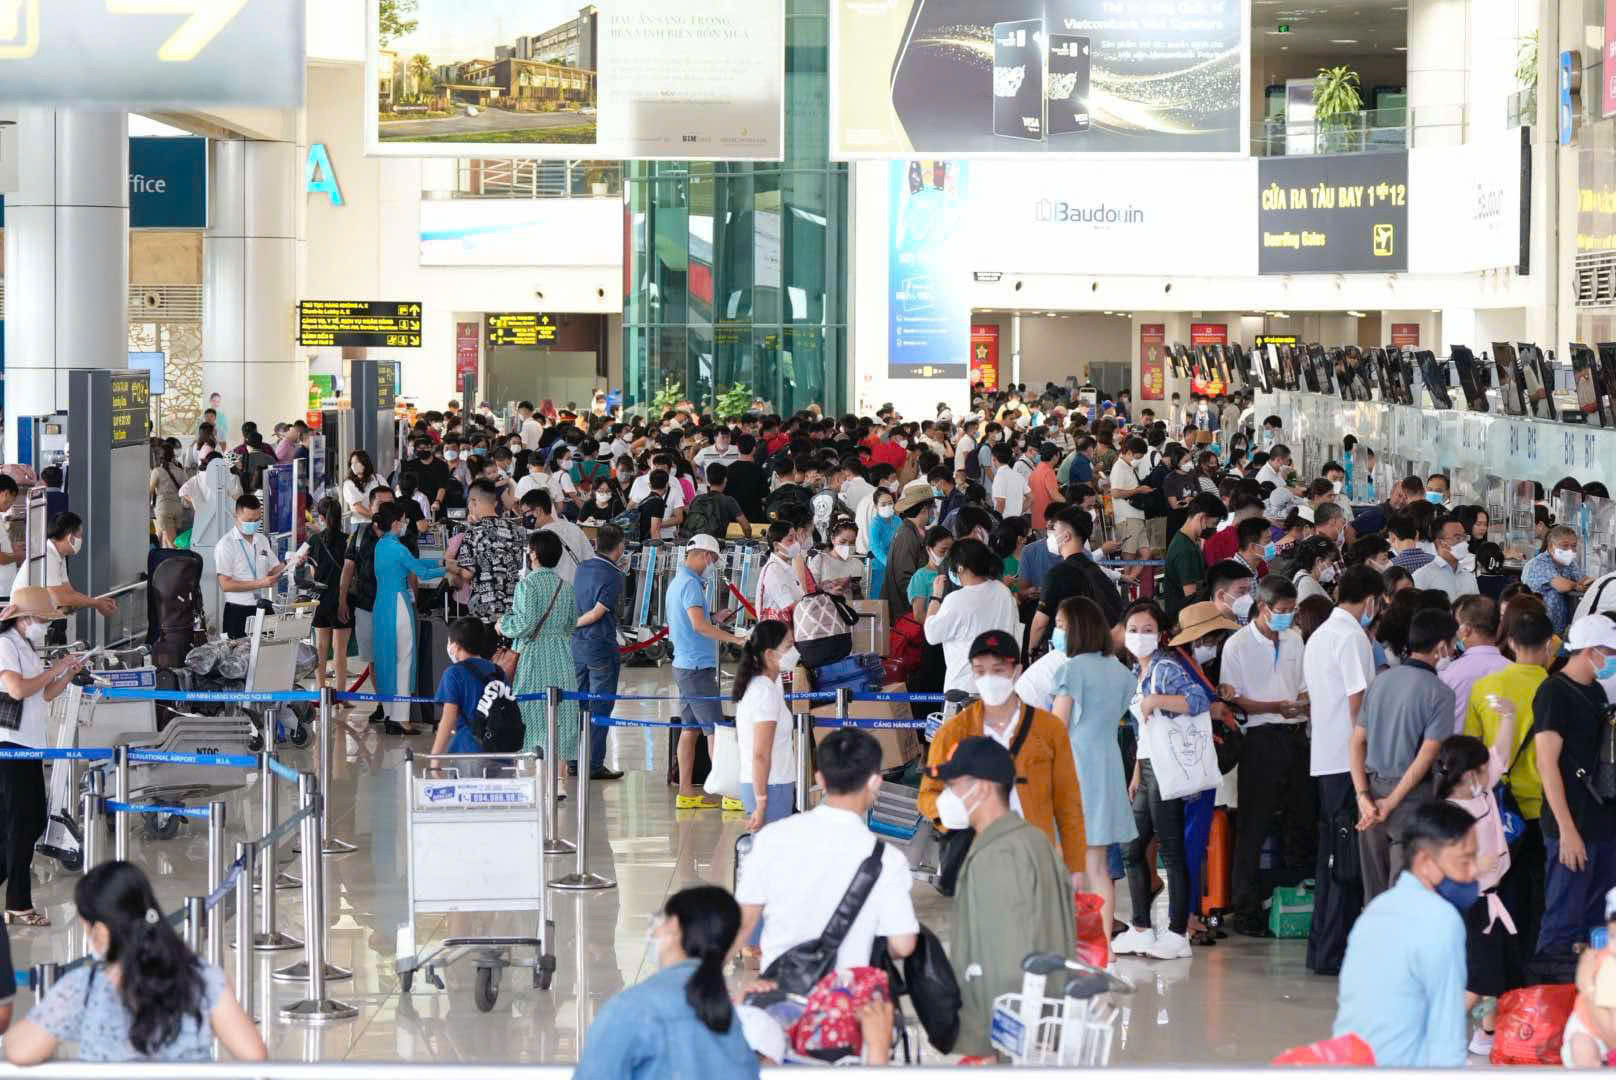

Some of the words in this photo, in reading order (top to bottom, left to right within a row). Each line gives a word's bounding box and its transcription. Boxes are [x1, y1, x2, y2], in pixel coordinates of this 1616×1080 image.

[306, 143, 344, 205] A
[1290, 187, 1308, 209] RA
[1312, 182, 1335, 208] TÀU
[1339, 186, 1364, 207] BAY
[1055, 203, 1144, 223] Baudouin
